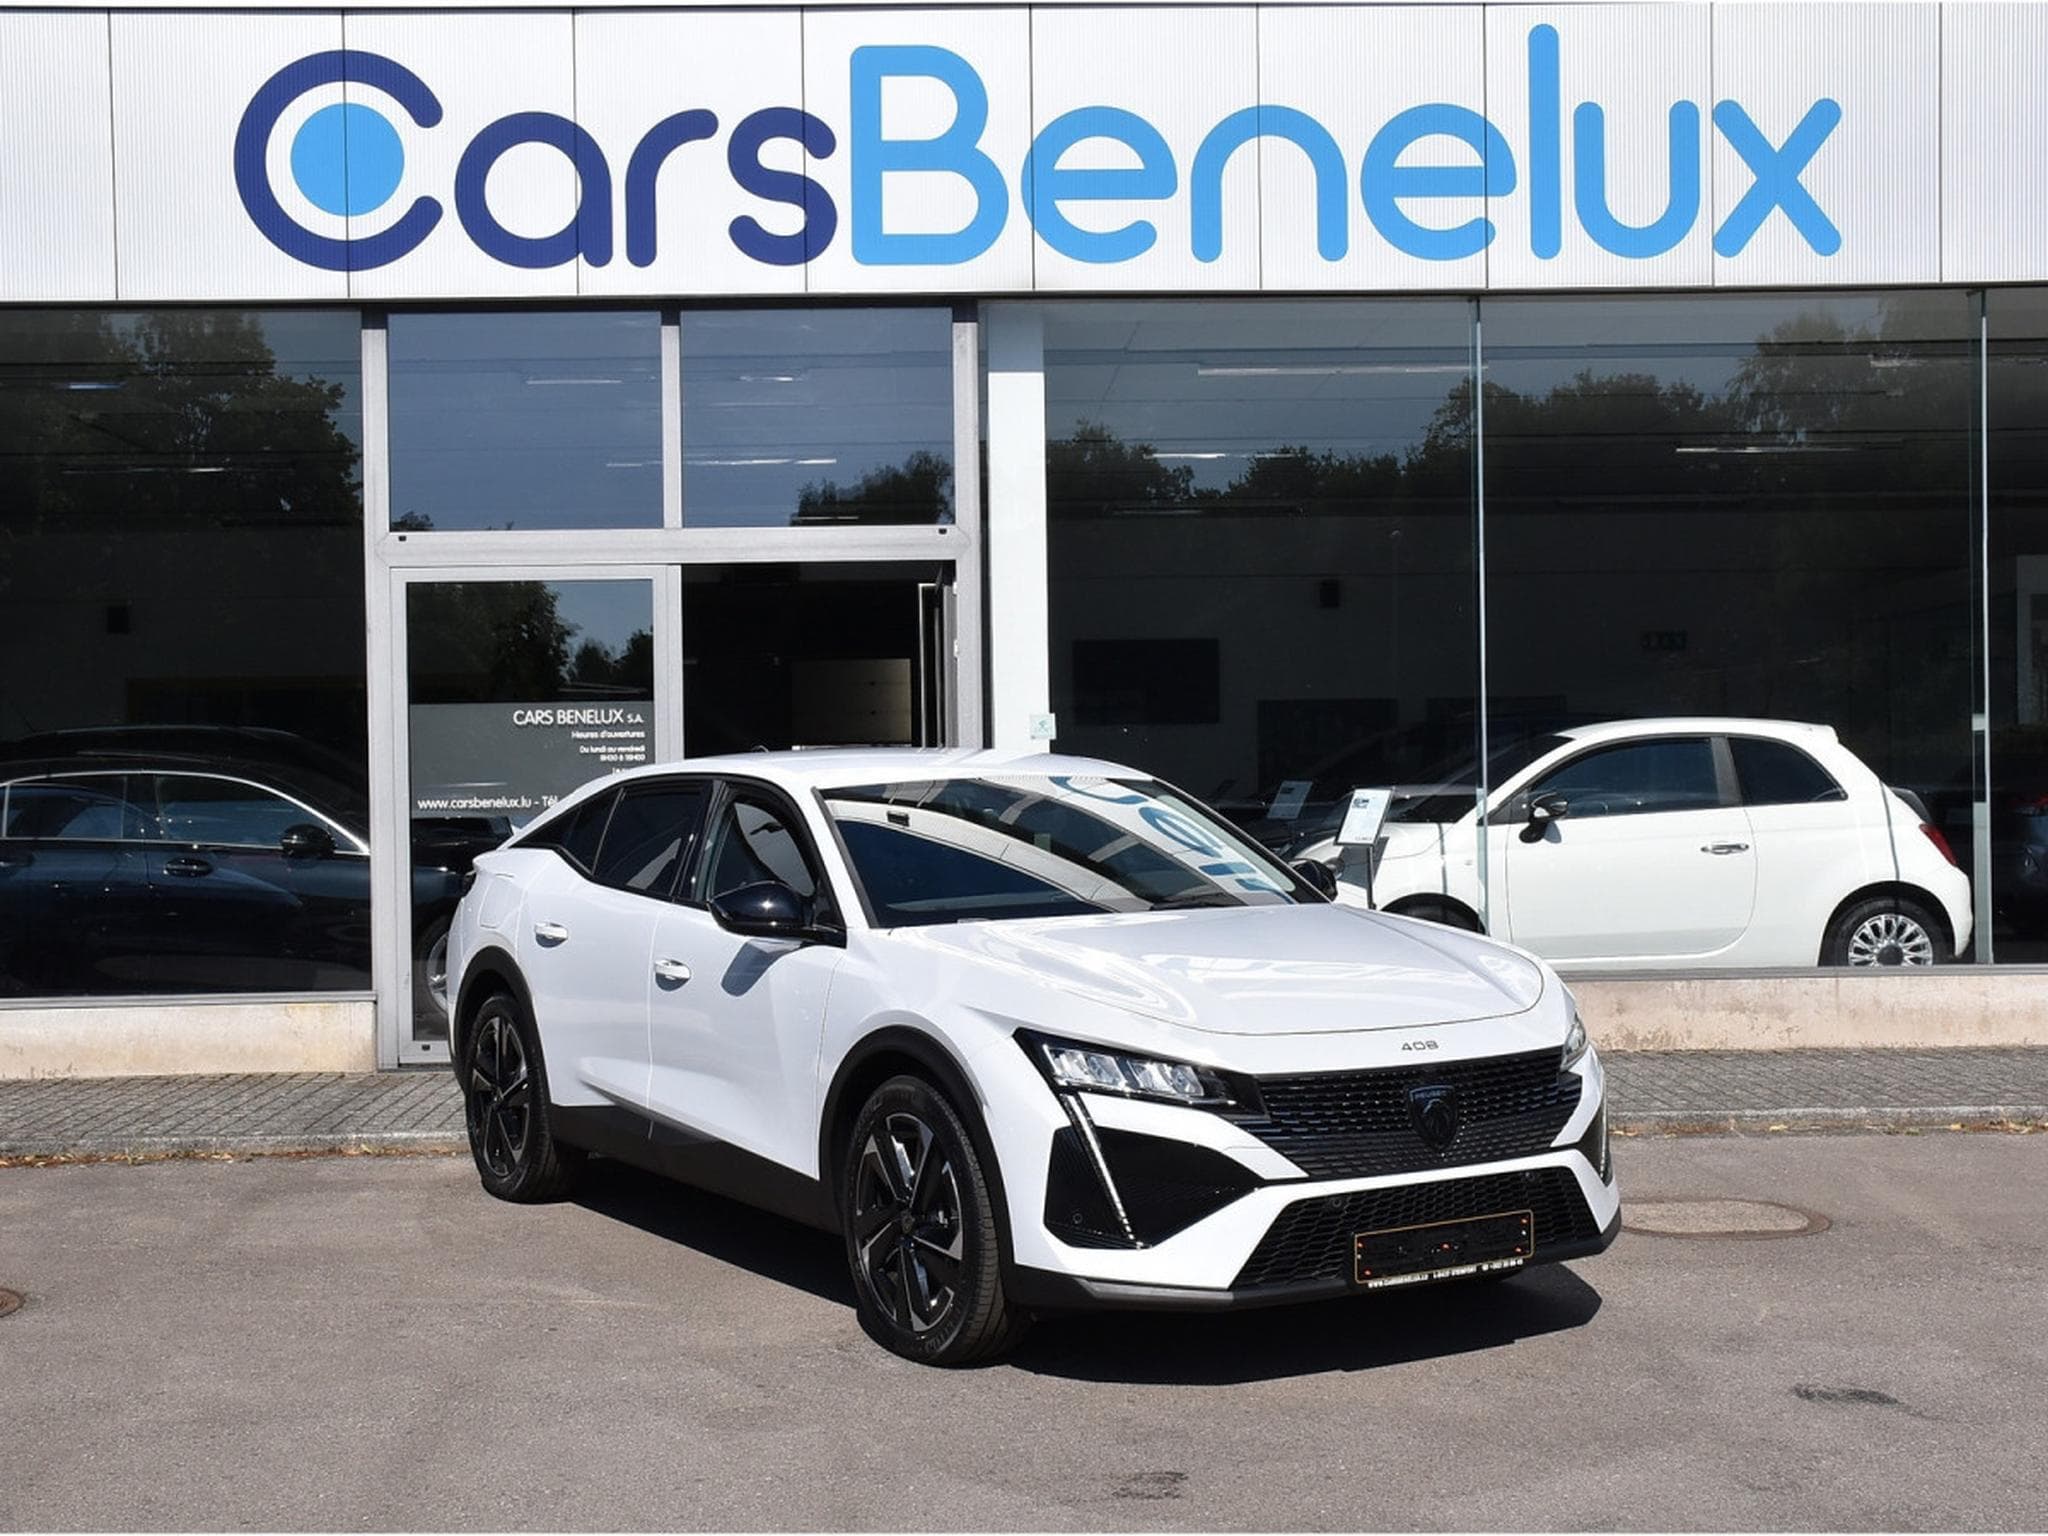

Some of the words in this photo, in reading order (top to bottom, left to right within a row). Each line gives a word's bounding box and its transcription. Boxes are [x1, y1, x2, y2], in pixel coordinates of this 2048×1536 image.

[234, 24, 1842, 272] CarsBenelux
[512, 710, 554, 725] CARS
[557, 709, 624, 724] BENELUX
[417, 796, 532, 809] www.carsbenelux.lu
[1402, 1040, 1439, 1051] 408
